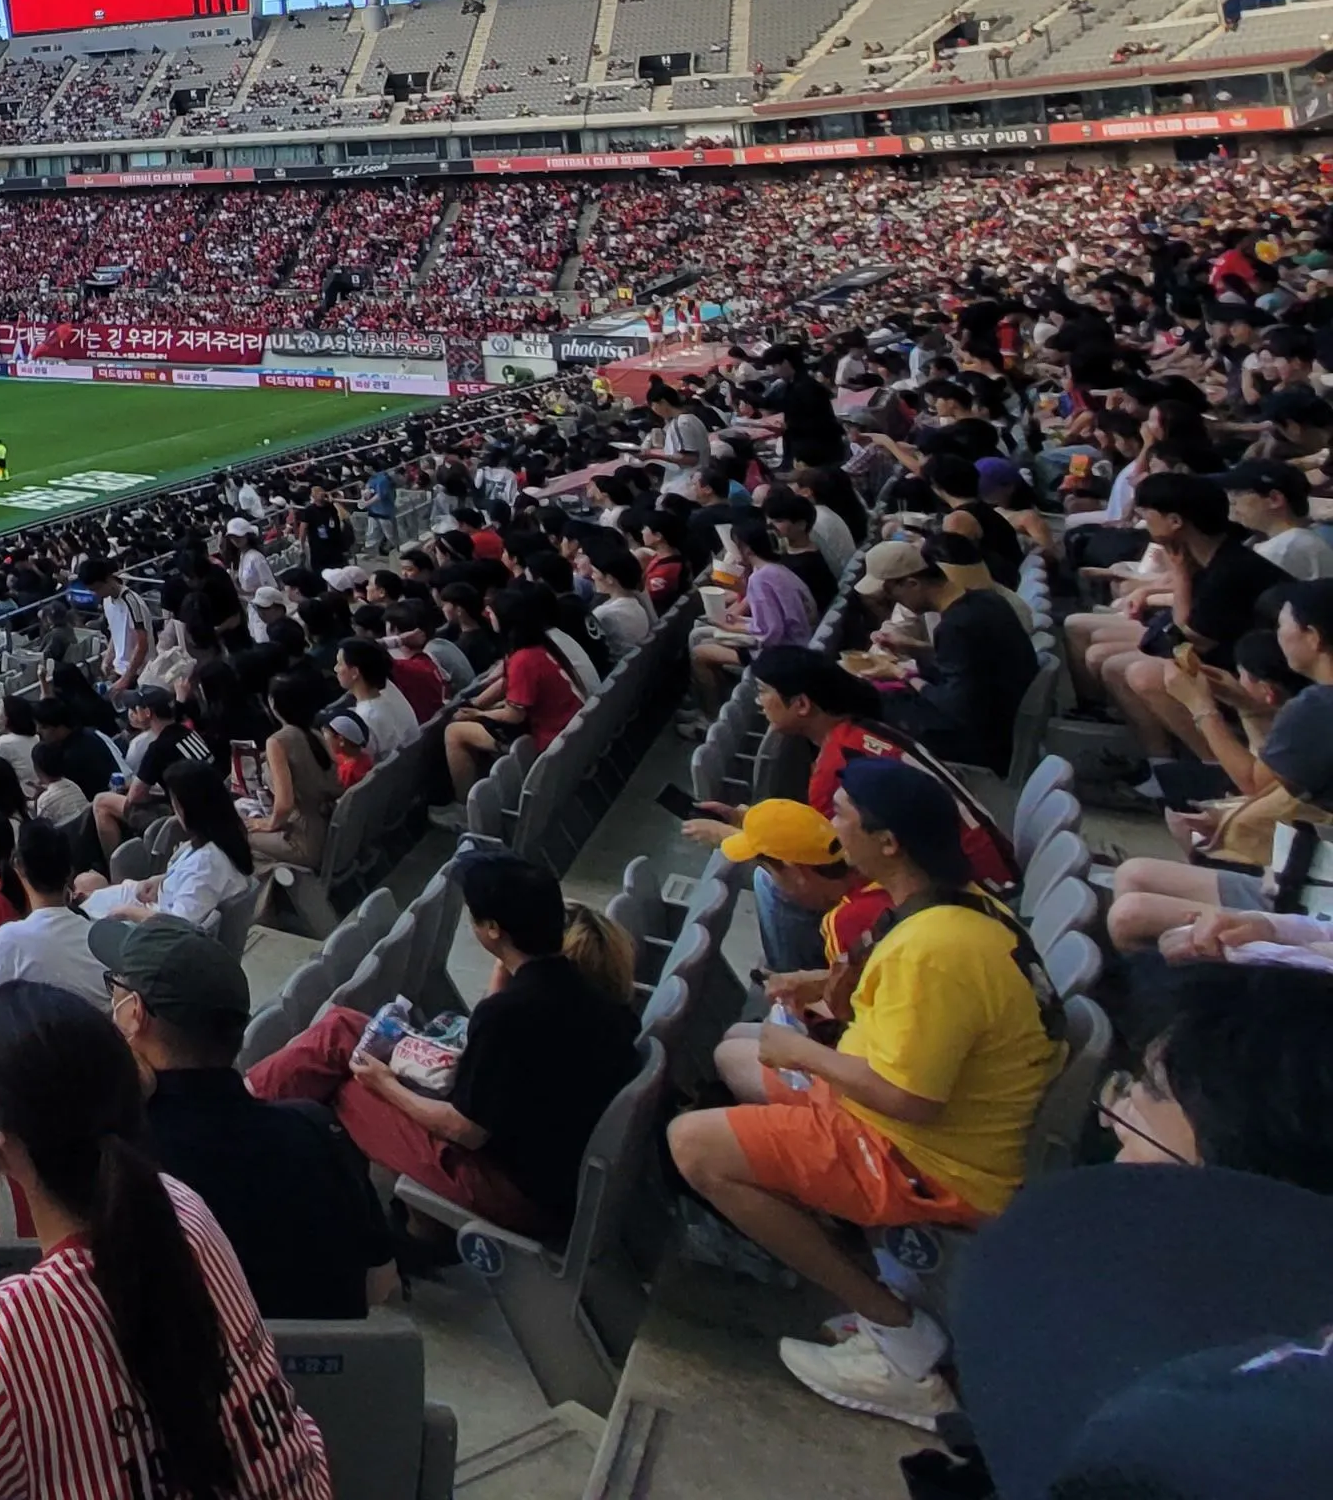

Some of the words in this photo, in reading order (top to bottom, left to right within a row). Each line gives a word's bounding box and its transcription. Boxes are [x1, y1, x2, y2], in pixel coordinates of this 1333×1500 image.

[961, 132, 990, 146] SKY
[995, 130, 1027, 144] PUB
[1033, 129, 1042, 141] 1
[546, 156, 591, 168] FOOTBALL
[593, 156, 618, 167] CLUB
[71, 328, 102, 350] 가는
[107, 328, 122, 350] 길
[126, 328, 173, 351] 우리가
[271, 332, 346, 350] ULTRAS
[899, 1226, 922, 1247] A
[475, 1237, 489, 1256] A
[470, 1252, 493, 1272] 21
[898, 1247, 929, 1268] 22
